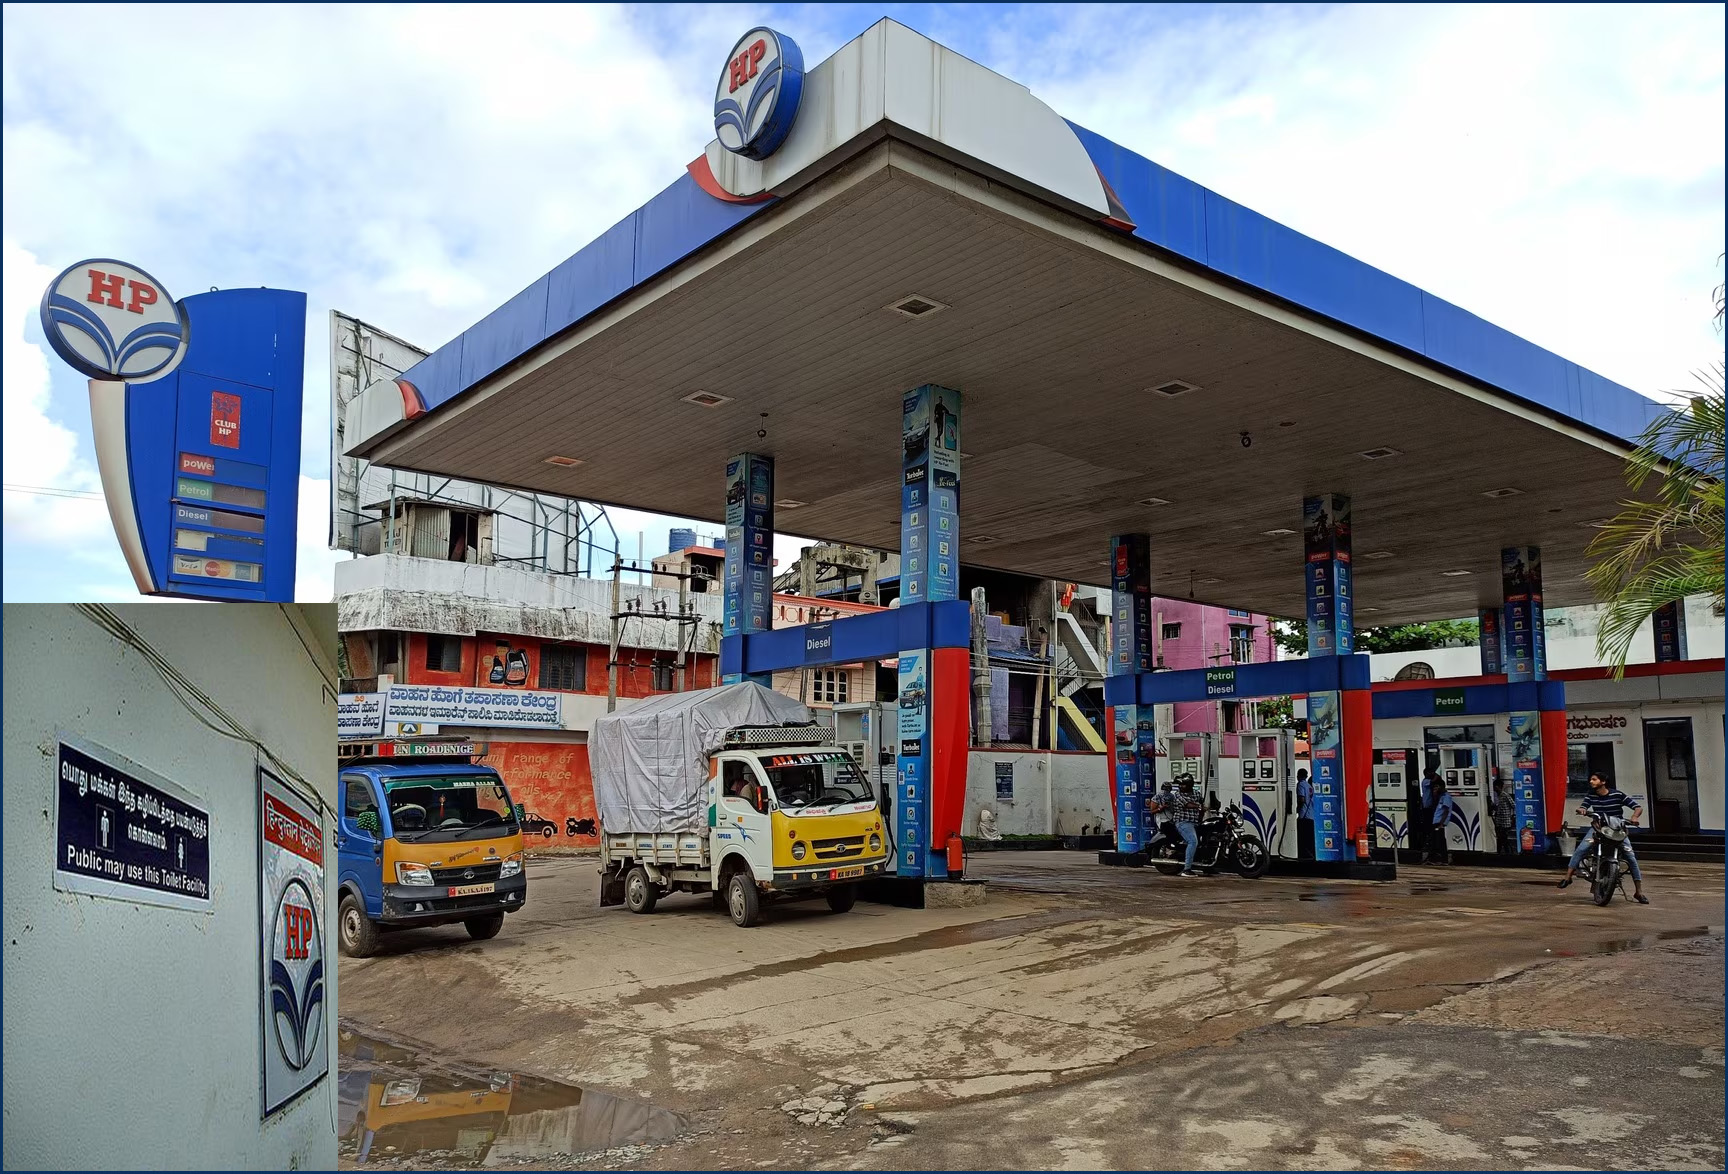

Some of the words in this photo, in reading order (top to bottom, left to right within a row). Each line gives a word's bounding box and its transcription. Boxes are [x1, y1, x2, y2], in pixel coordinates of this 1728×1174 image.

[729, 39, 767, 94] HP
[87, 269, 158, 315] HP
[214, 419, 237, 429] CLUB
[218, 428, 232, 436] HP
[179, 484, 209, 496] Petrol
[178, 509, 208, 520] Diesel
[807, 636, 831, 650] Diesel
[1207, 671, 1234, 680] Petrol
[1208, 685, 1234, 694] Diesel
[390, 687, 430, 702] ವಾಹನ
[431, 686, 463, 704] ಹೊಗೆ
[465, 690, 519, 707] ತಪಾಸಣಾ
[521, 692, 557, 711] ಕೇಂದ್ರ
[1435, 696, 1464, 706] Petrol
[1566, 714, 1627, 731] ಗಭೂಷಣ
[512, 751, 549, 765] range
[559, 752, 575, 764] of
[772, 754, 798, 767] ALL
[797, 753, 812, 765] IS
[503, 767, 572, 780] rformance
[61, 760, 88, 797] பொது
[90, 771, 117, 800] மக்கள்
[117, 781, 136, 813] இந்த
[520, 783, 541, 795] oils
[67, 844, 103, 870] Public
[104, 860, 125, 881] may
[127, 864, 143, 881] use
[144, 865, 160, 882] this
[161, 868, 183, 889] Toilet
[182, 874, 208, 898] Facility.
[285, 903, 313, 961] HP
